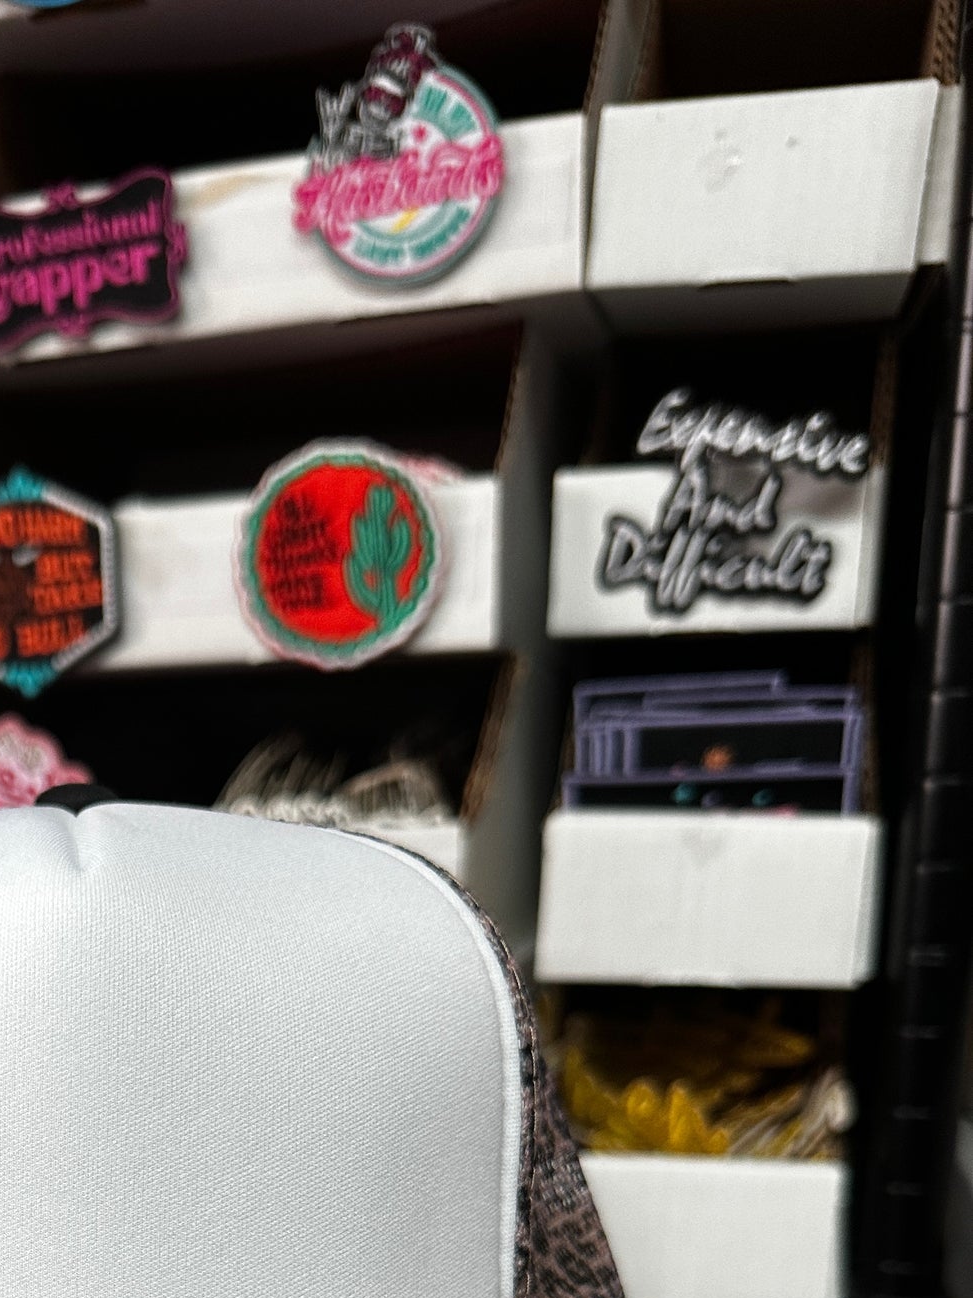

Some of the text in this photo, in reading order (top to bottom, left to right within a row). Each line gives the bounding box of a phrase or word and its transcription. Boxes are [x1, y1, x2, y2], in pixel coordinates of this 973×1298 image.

[636, 387, 869, 474] Expensive
[662, 462, 780, 532] And
[601, 518, 831, 611] Difficult
